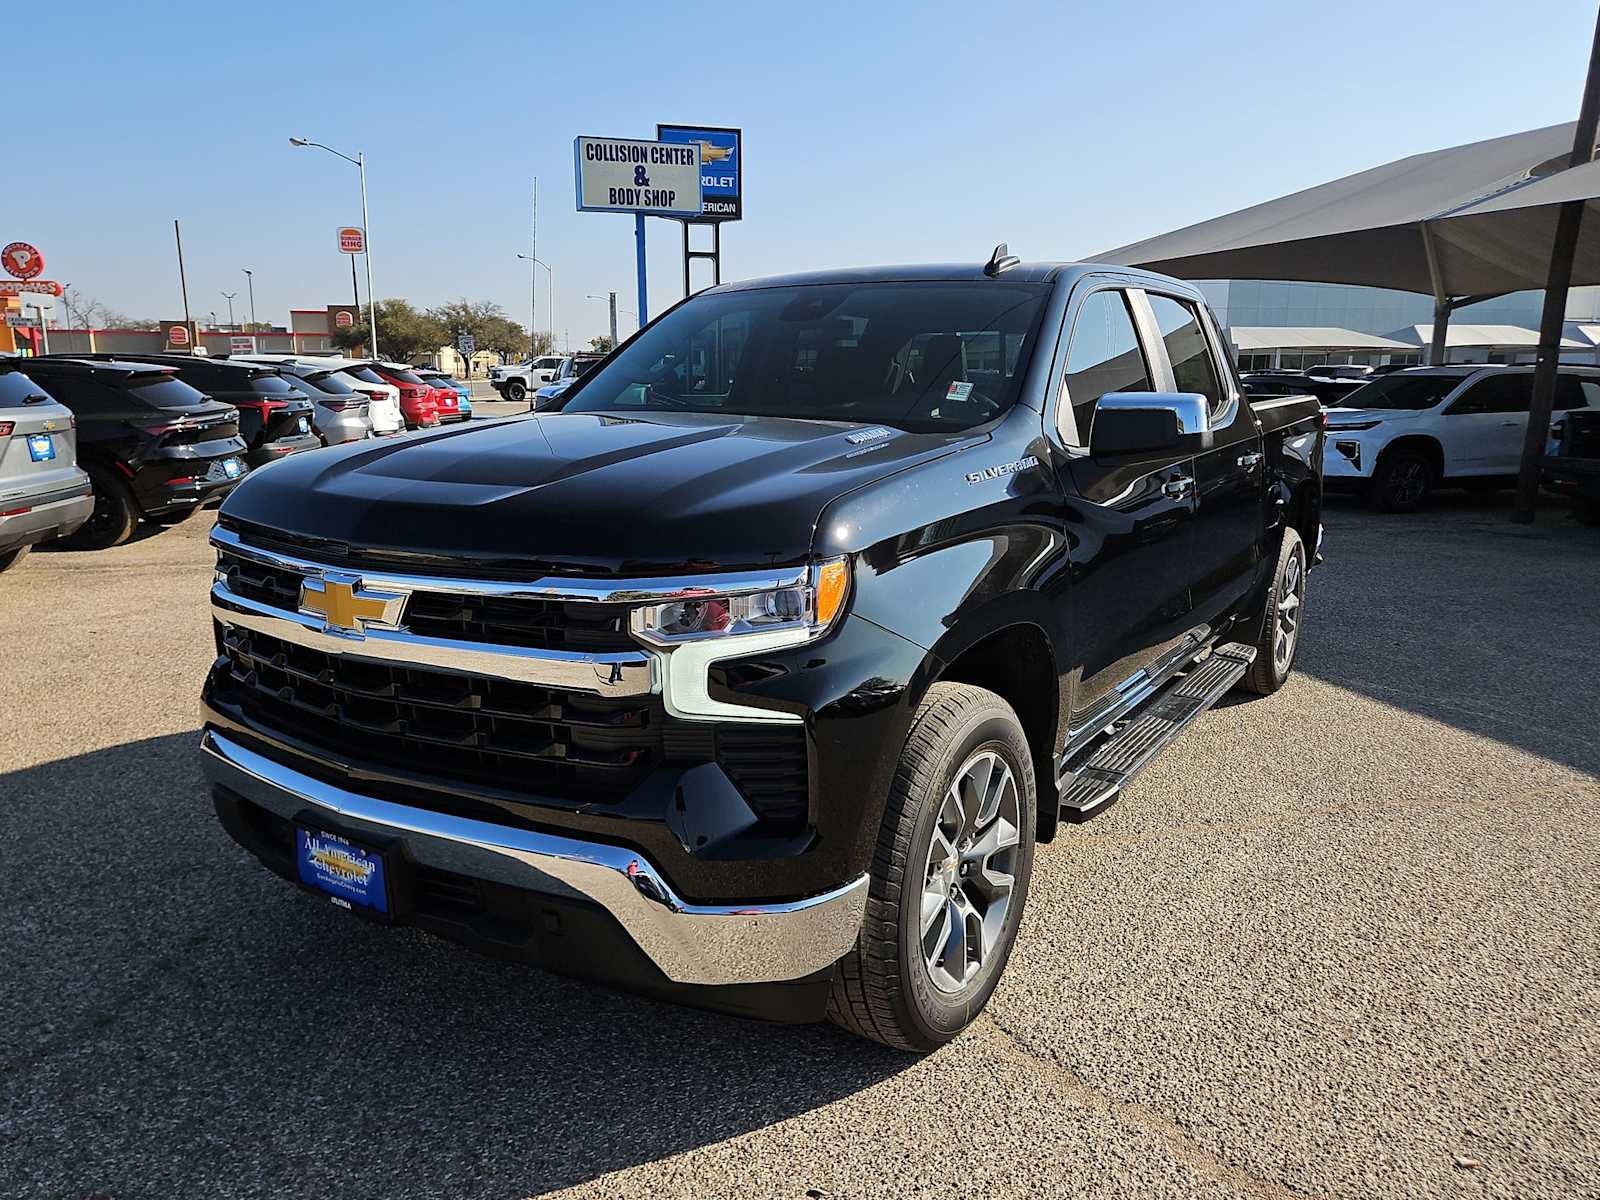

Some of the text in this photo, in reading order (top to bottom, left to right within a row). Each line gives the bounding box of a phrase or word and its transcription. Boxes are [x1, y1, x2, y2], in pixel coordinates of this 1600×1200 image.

[586, 143, 694, 165] COLLISION CENTER
[634, 165, 650, 186] &
[609, 188, 676, 207] BODY SHOP
[968, 455, 1040, 484] SILVERADO
[304, 838, 376, 873] All American
[313, 855, 369, 886] Chevrolet
